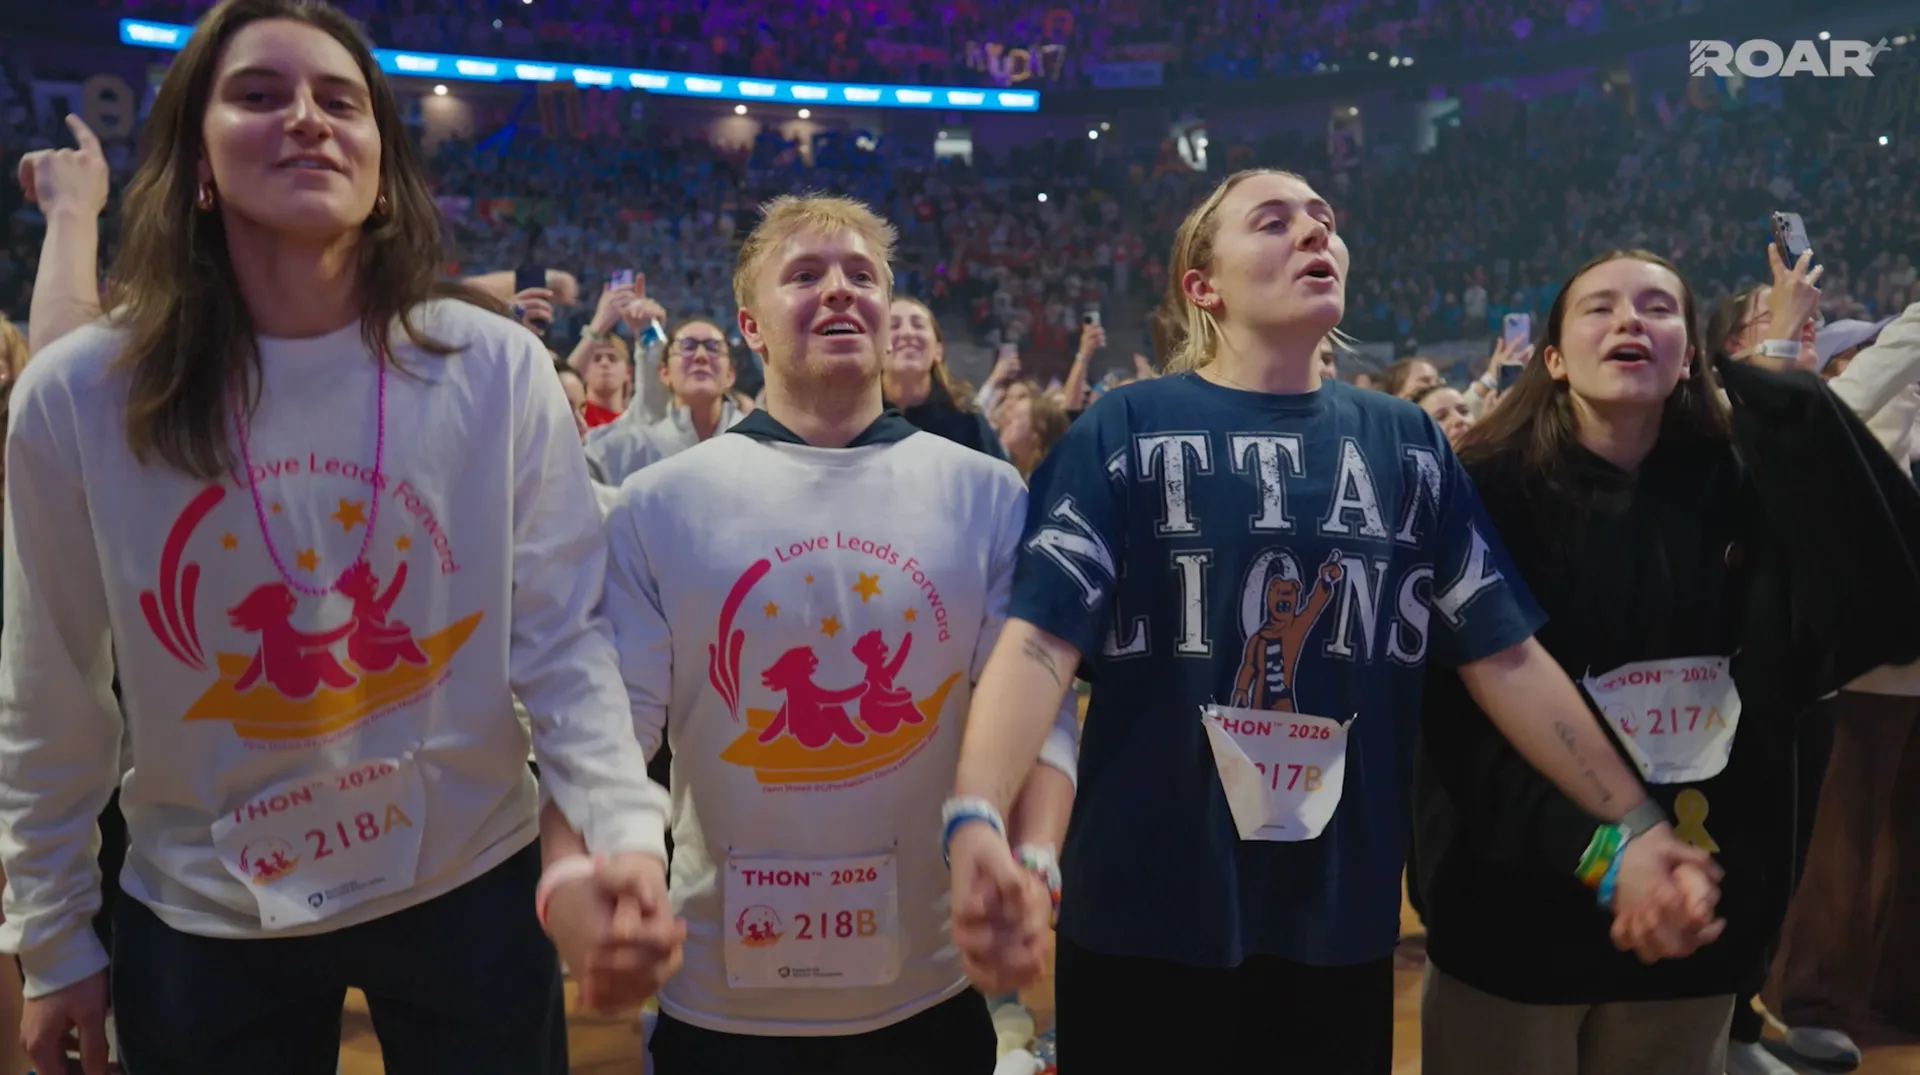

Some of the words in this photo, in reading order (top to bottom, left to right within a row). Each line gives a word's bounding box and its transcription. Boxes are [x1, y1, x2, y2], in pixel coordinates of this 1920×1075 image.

[392, 479, 461, 576] Forward
[774, 534, 830, 563] Love
[836, 531, 901, 566] Leads
[901, 556, 951, 644] Forward
[1681, 665, 1718, 683] 2026
[1288, 723, 1331, 740] 2026
[1646, 704, 1727, 735] 217A
[304, 801, 414, 861] 218A
[830, 867, 878, 886] 2026
[794, 908, 878, 940] 218B
